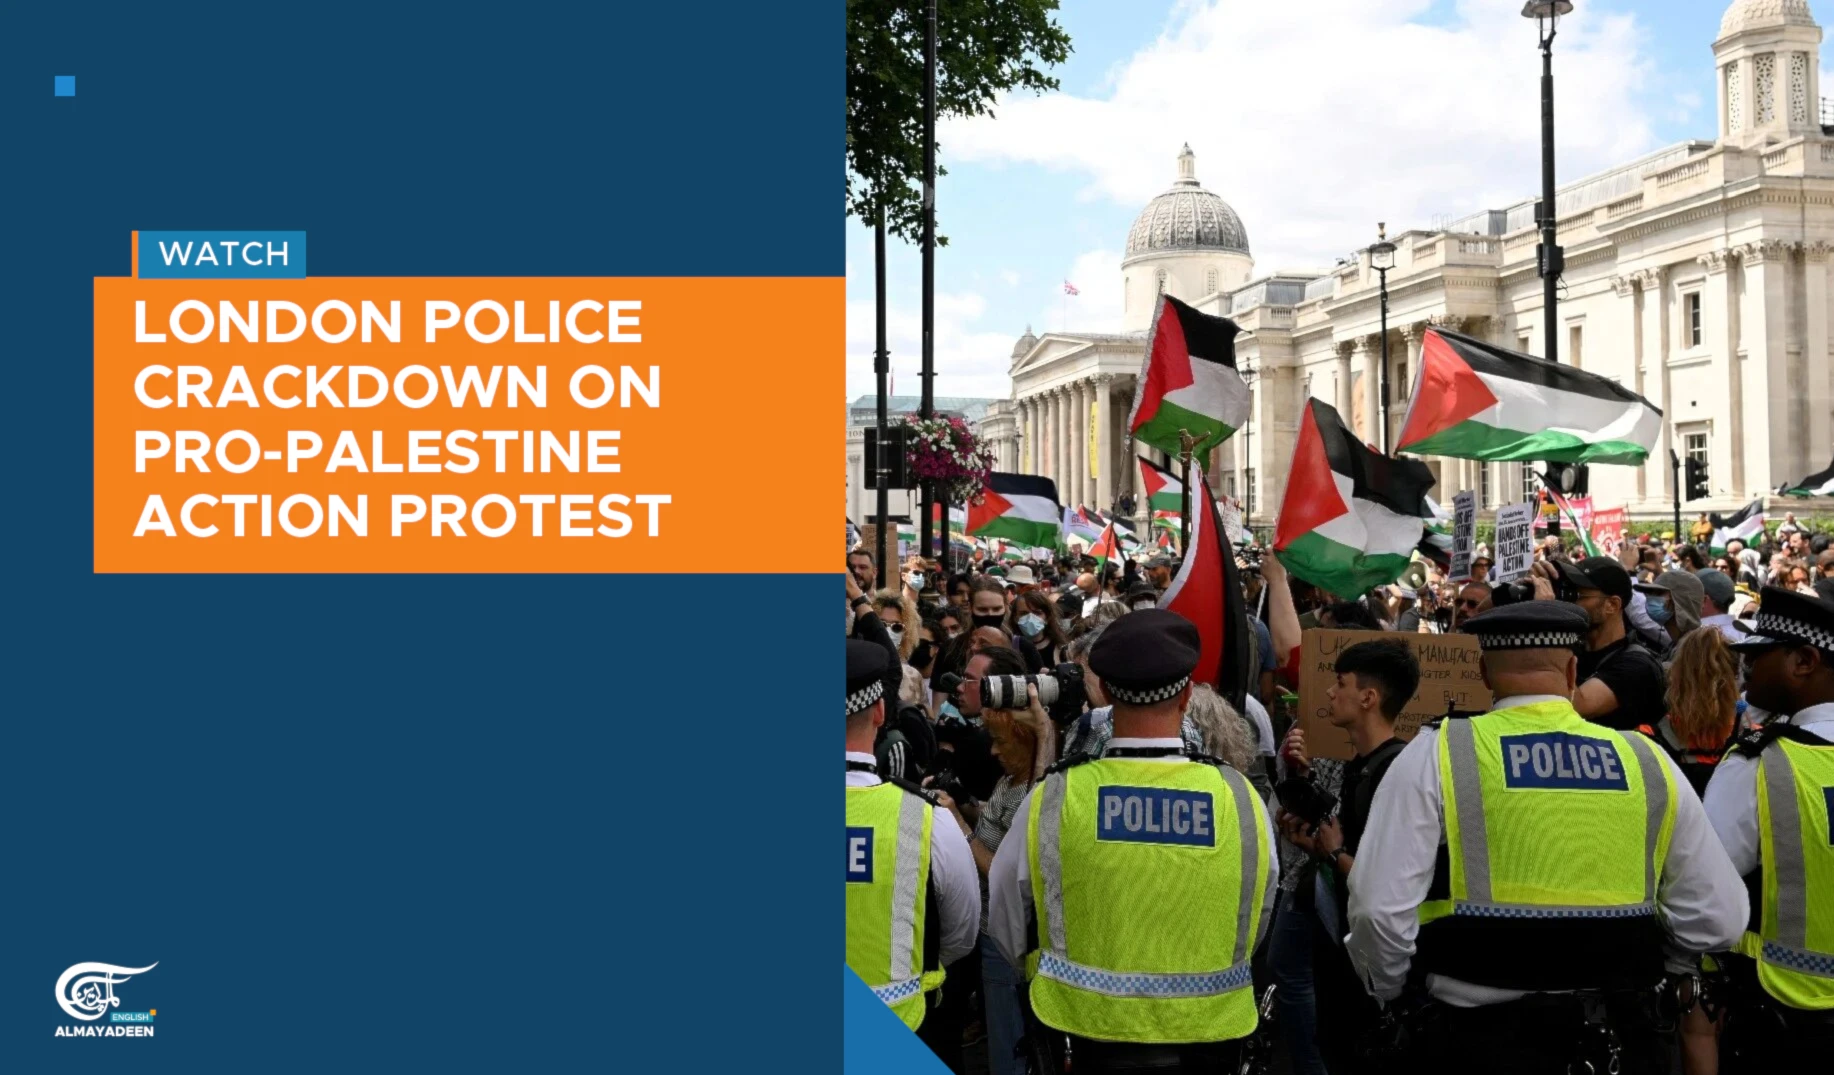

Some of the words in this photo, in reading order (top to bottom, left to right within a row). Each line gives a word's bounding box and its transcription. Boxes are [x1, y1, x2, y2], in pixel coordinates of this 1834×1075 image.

[1498, 526, 1516, 544] HANDS
[1516, 523, 1530, 539] OFF
[1498, 538, 1530, 559] PALESTINE
[1507, 742, 1621, 780] POLICE
[1103, 795, 1210, 836] POLICE
